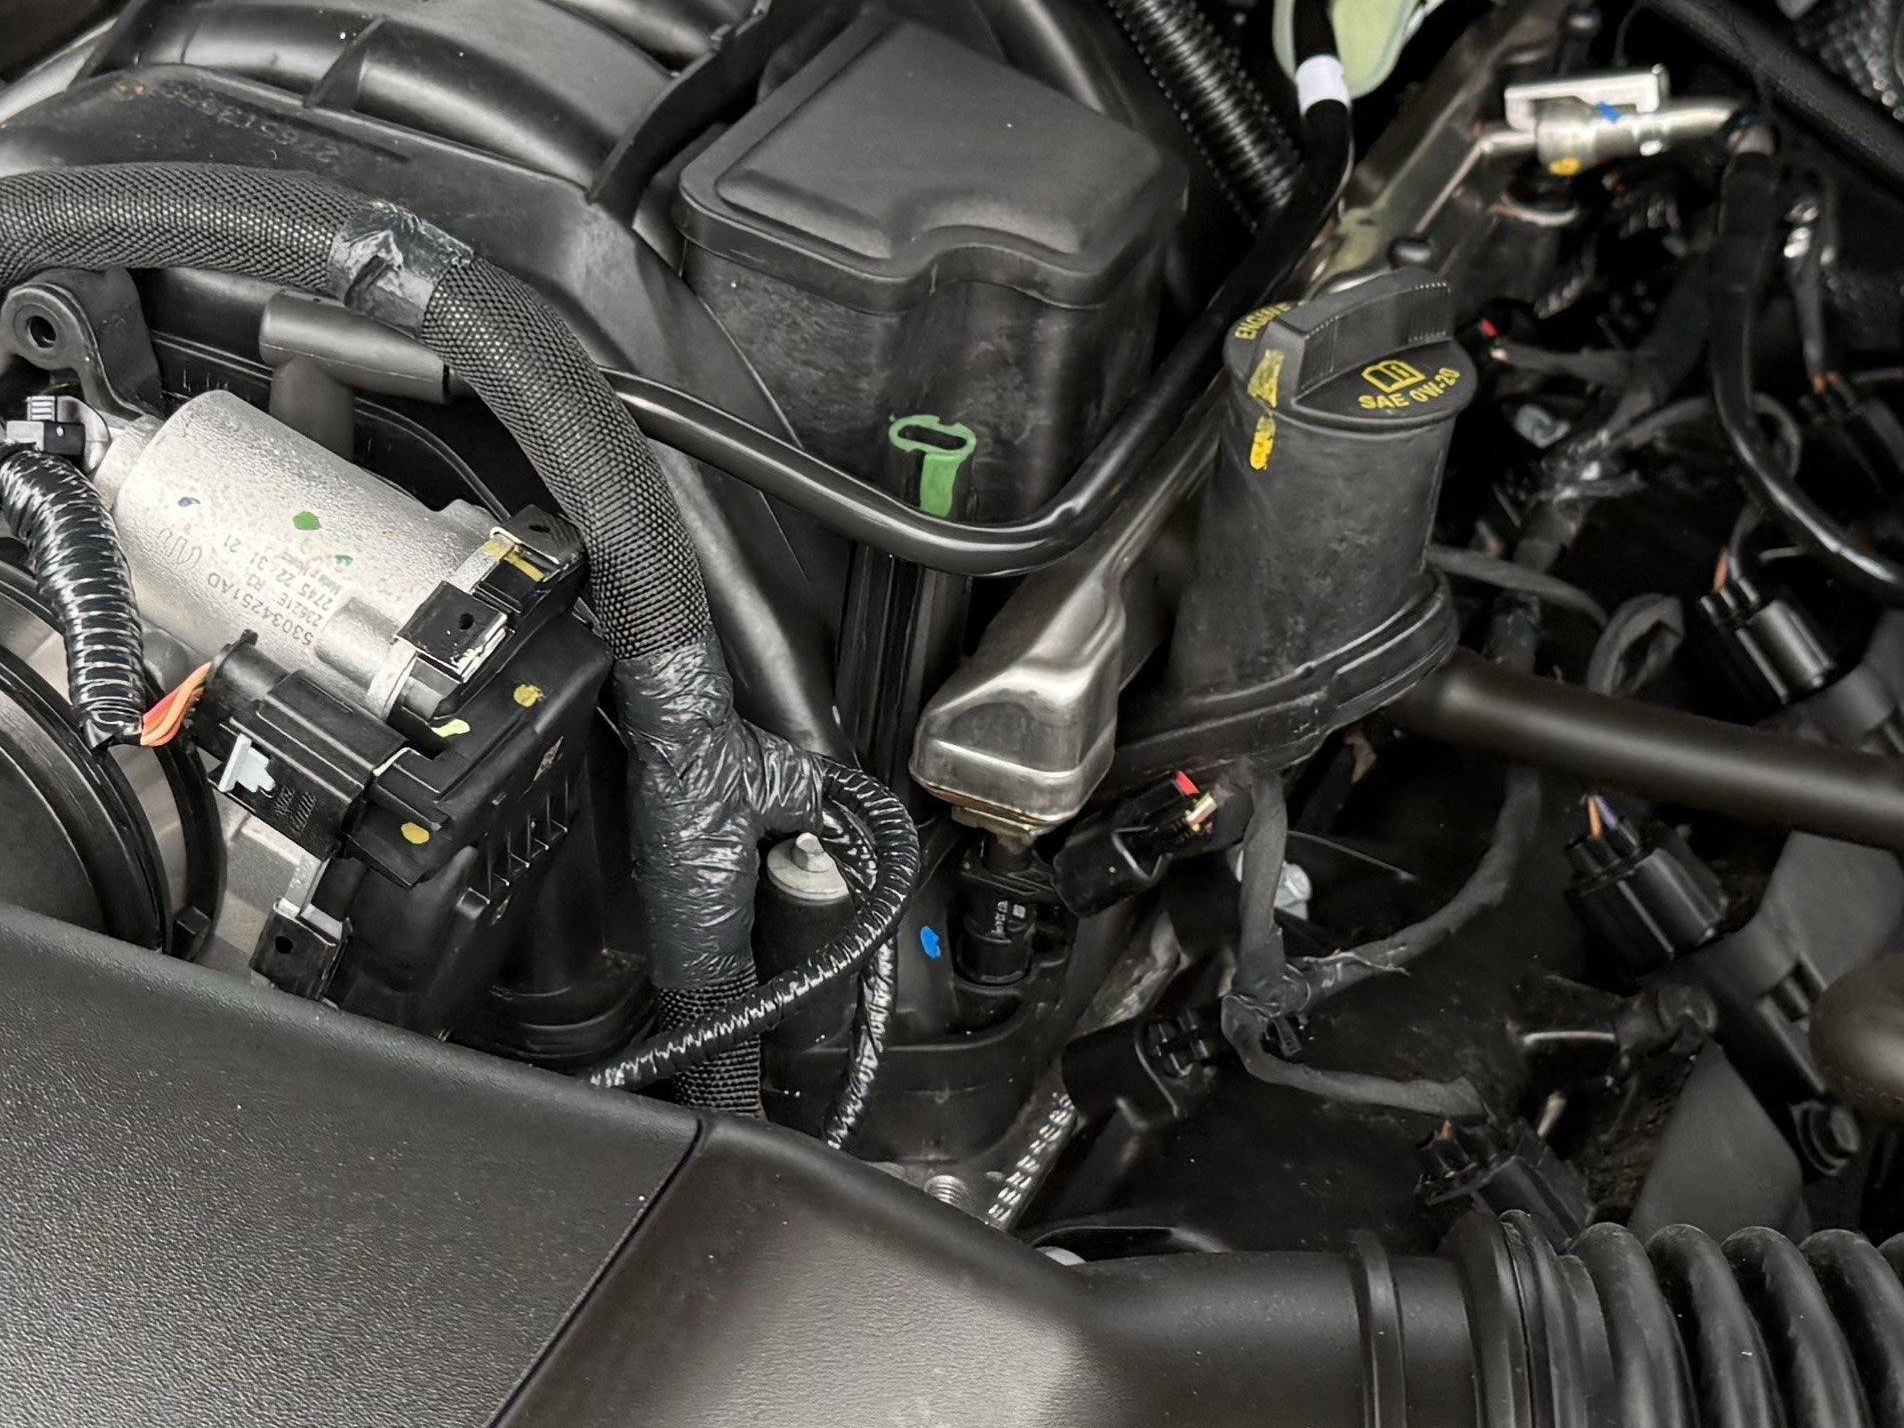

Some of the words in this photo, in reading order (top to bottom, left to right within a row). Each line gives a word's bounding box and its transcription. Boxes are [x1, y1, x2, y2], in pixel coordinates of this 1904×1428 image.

[1358, 394, 1409, 410] SAE
[1409, 366, 1460, 403] 0W-20
[207, 572, 314, 646] 53034251AD
